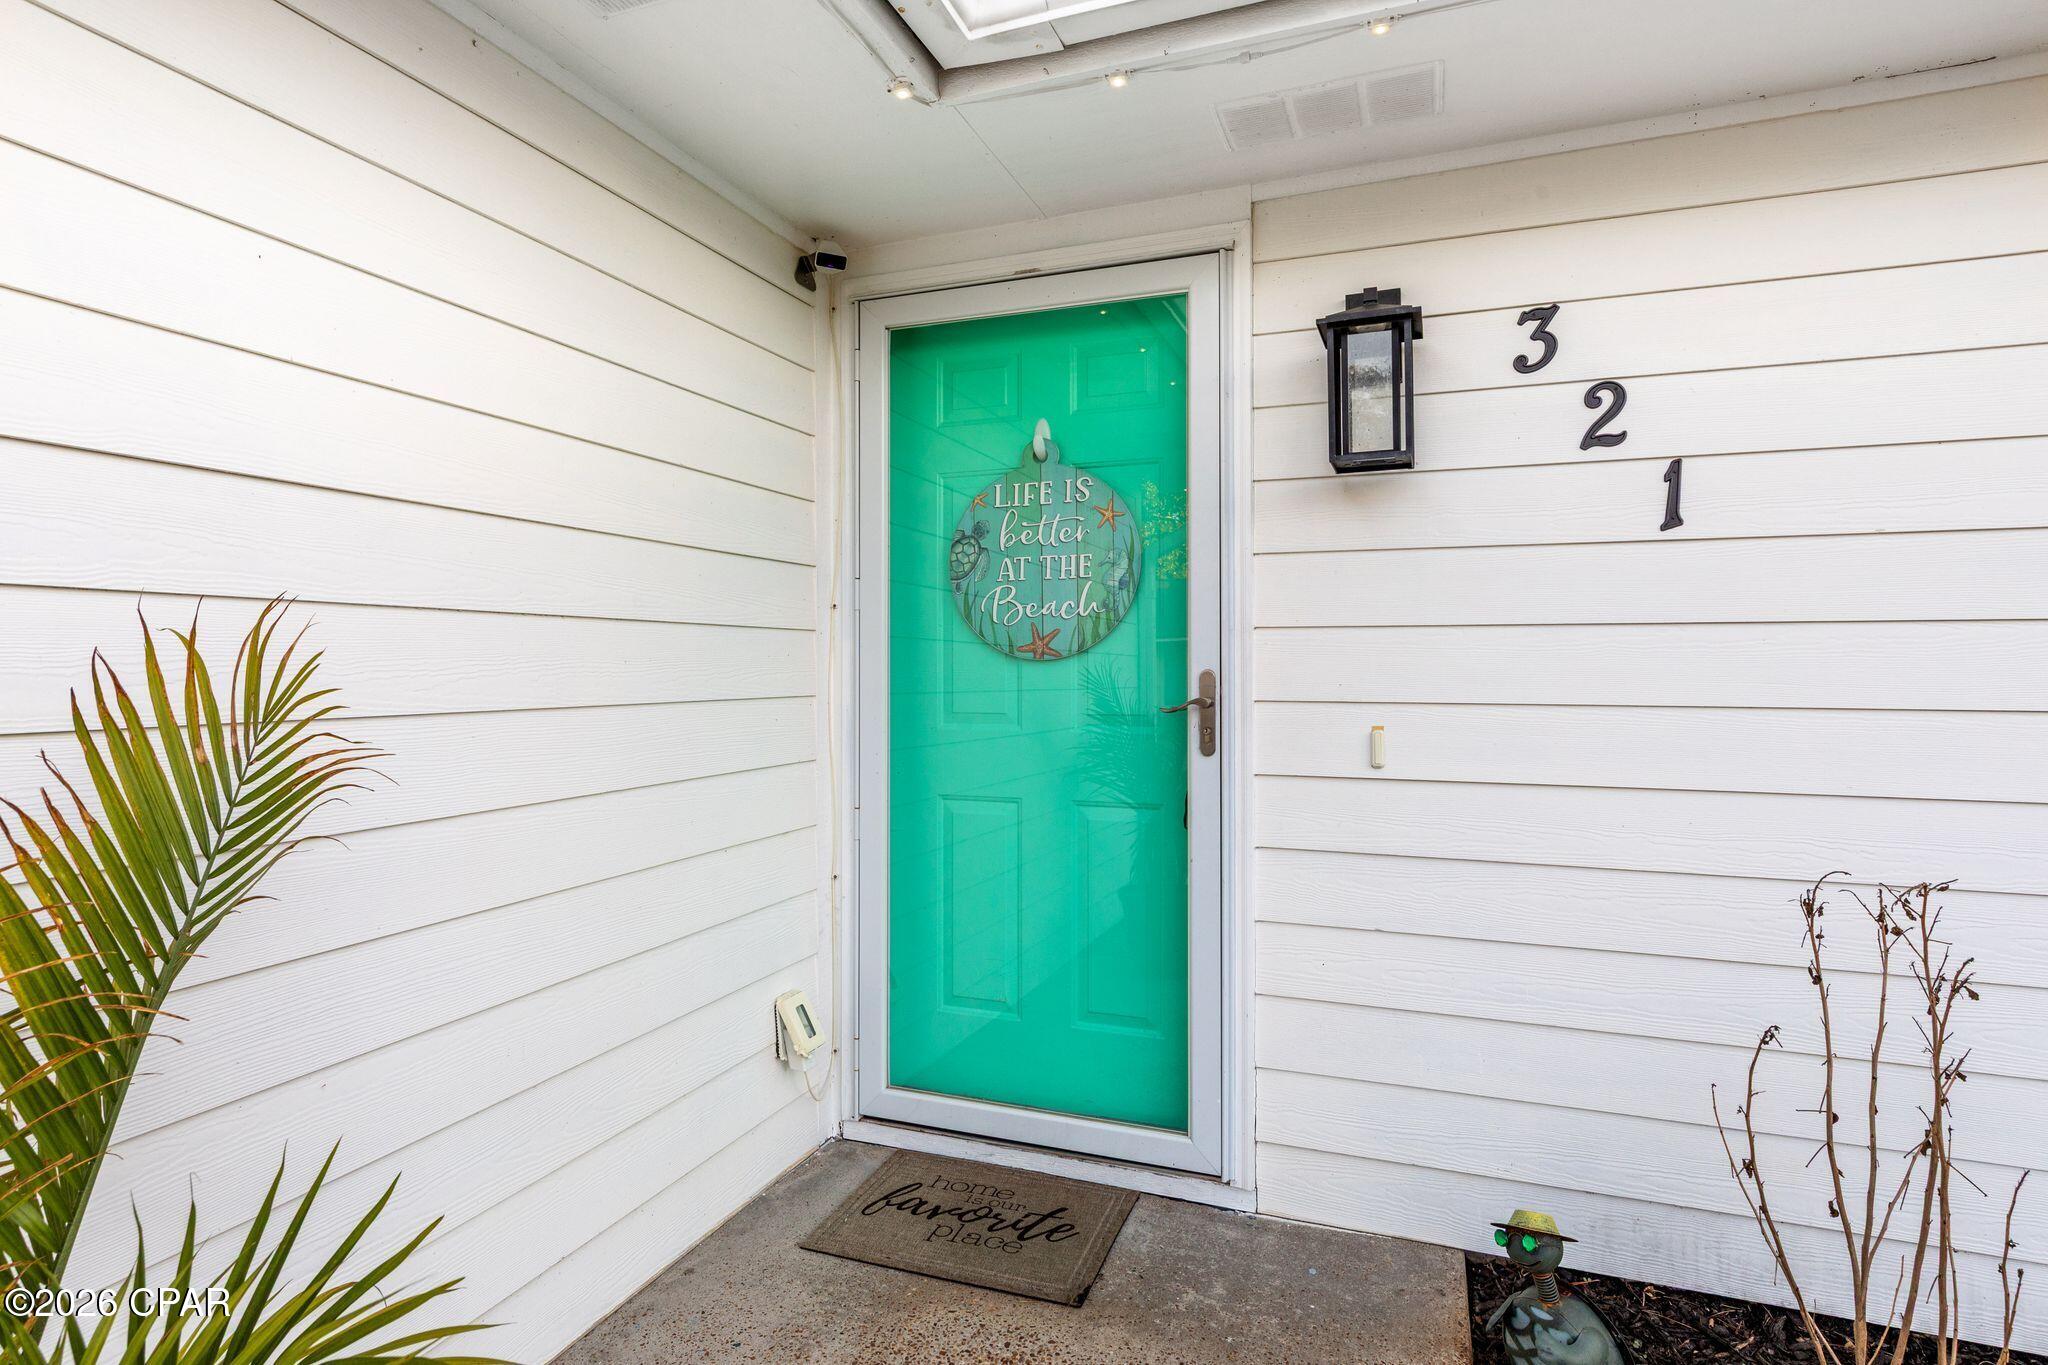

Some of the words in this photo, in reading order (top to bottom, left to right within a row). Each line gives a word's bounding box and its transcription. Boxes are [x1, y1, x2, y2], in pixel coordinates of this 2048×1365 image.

[994, 480, 1054, 509] LIFE
[1064, 476, 1095, 504] IS
[999, 508, 1091, 552] better
[996, 556, 1032, 583] AT
[1040, 553, 1094, 581] THE
[981, 580, 1106, 627] Beach
[926, 1174, 1016, 1200] home
[962, 1193, 984, 1206] is
[988, 1199, 1026, 1213] our
[861, 1181, 1080, 1243] favorite
[922, 1222, 1024, 1255] place
